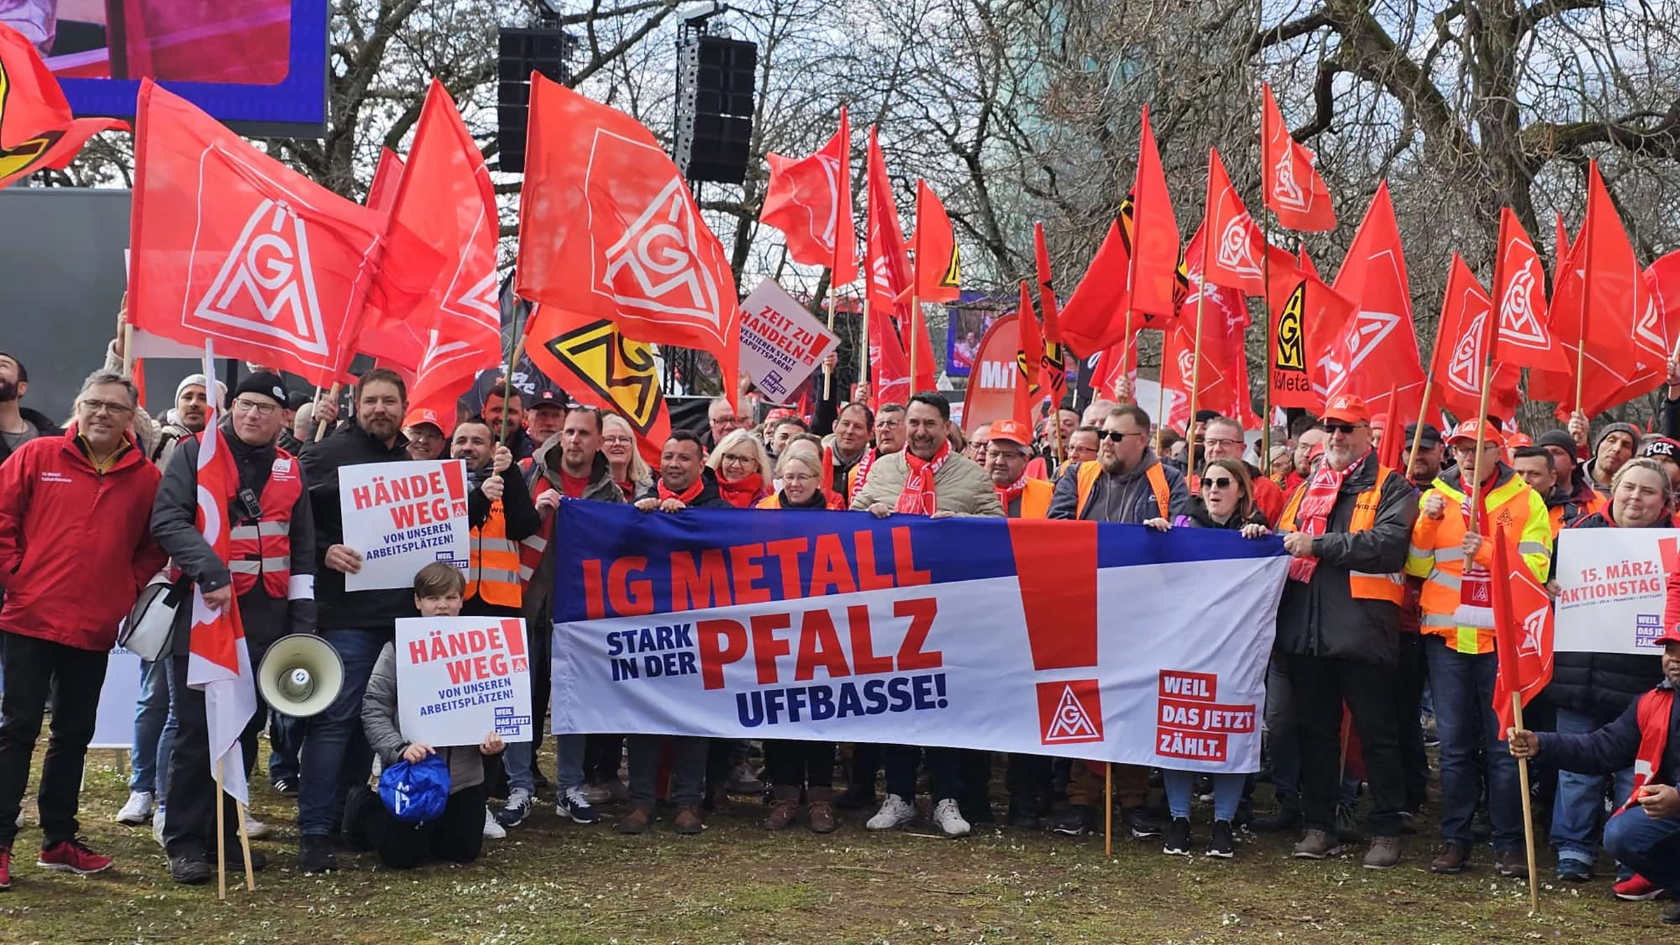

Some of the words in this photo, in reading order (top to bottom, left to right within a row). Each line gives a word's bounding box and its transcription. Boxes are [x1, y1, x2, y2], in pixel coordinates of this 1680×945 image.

[740, 311, 805, 359] HANDELN
[760, 305, 793, 332] ZEIT
[793, 328, 814, 346] ZU
[740, 326, 776, 353] VESTIEREN
[775, 349, 797, 366] STATT
[1646, 442, 1674, 457] FCK
[352, 471, 445, 510] HÄNDE
[390, 501, 449, 529] WEG
[366, 534, 454, 560] ARBEITSPLÄTZEN!
[383, 533, 404, 544] VON
[407, 523, 452, 540] UNSEREN
[582, 556, 654, 620] IG
[669, 526, 931, 613] METALL
[1581, 568, 1602, 582] 15.
[1606, 559, 1659, 580] MÄRZ:
[1561, 578, 1661, 604] AKTIONSTAG
[1638, 616, 1657, 624] WEIL
[1638, 628, 1654, 636] DAS
[409, 628, 503, 664] HÄNDE
[606, 623, 693, 656] STARK
[696, 597, 943, 691] PFALZ
[446, 654, 508, 684] WEG
[611, 658, 638, 681] IN
[645, 652, 698, 678] DER
[438, 687, 461, 699] VON
[464, 678, 511, 695] UNSEREN
[1163, 676, 1210, 697] WEIL
[420, 690, 514, 716] ARBEITSPLÄTZEN!
[736, 673, 949, 728] UFFBASSE!
[1162, 705, 1199, 726] DAS
[1202, 710, 1253, 731] JETZT
[1159, 732, 1221, 757] ZÄHLT.
